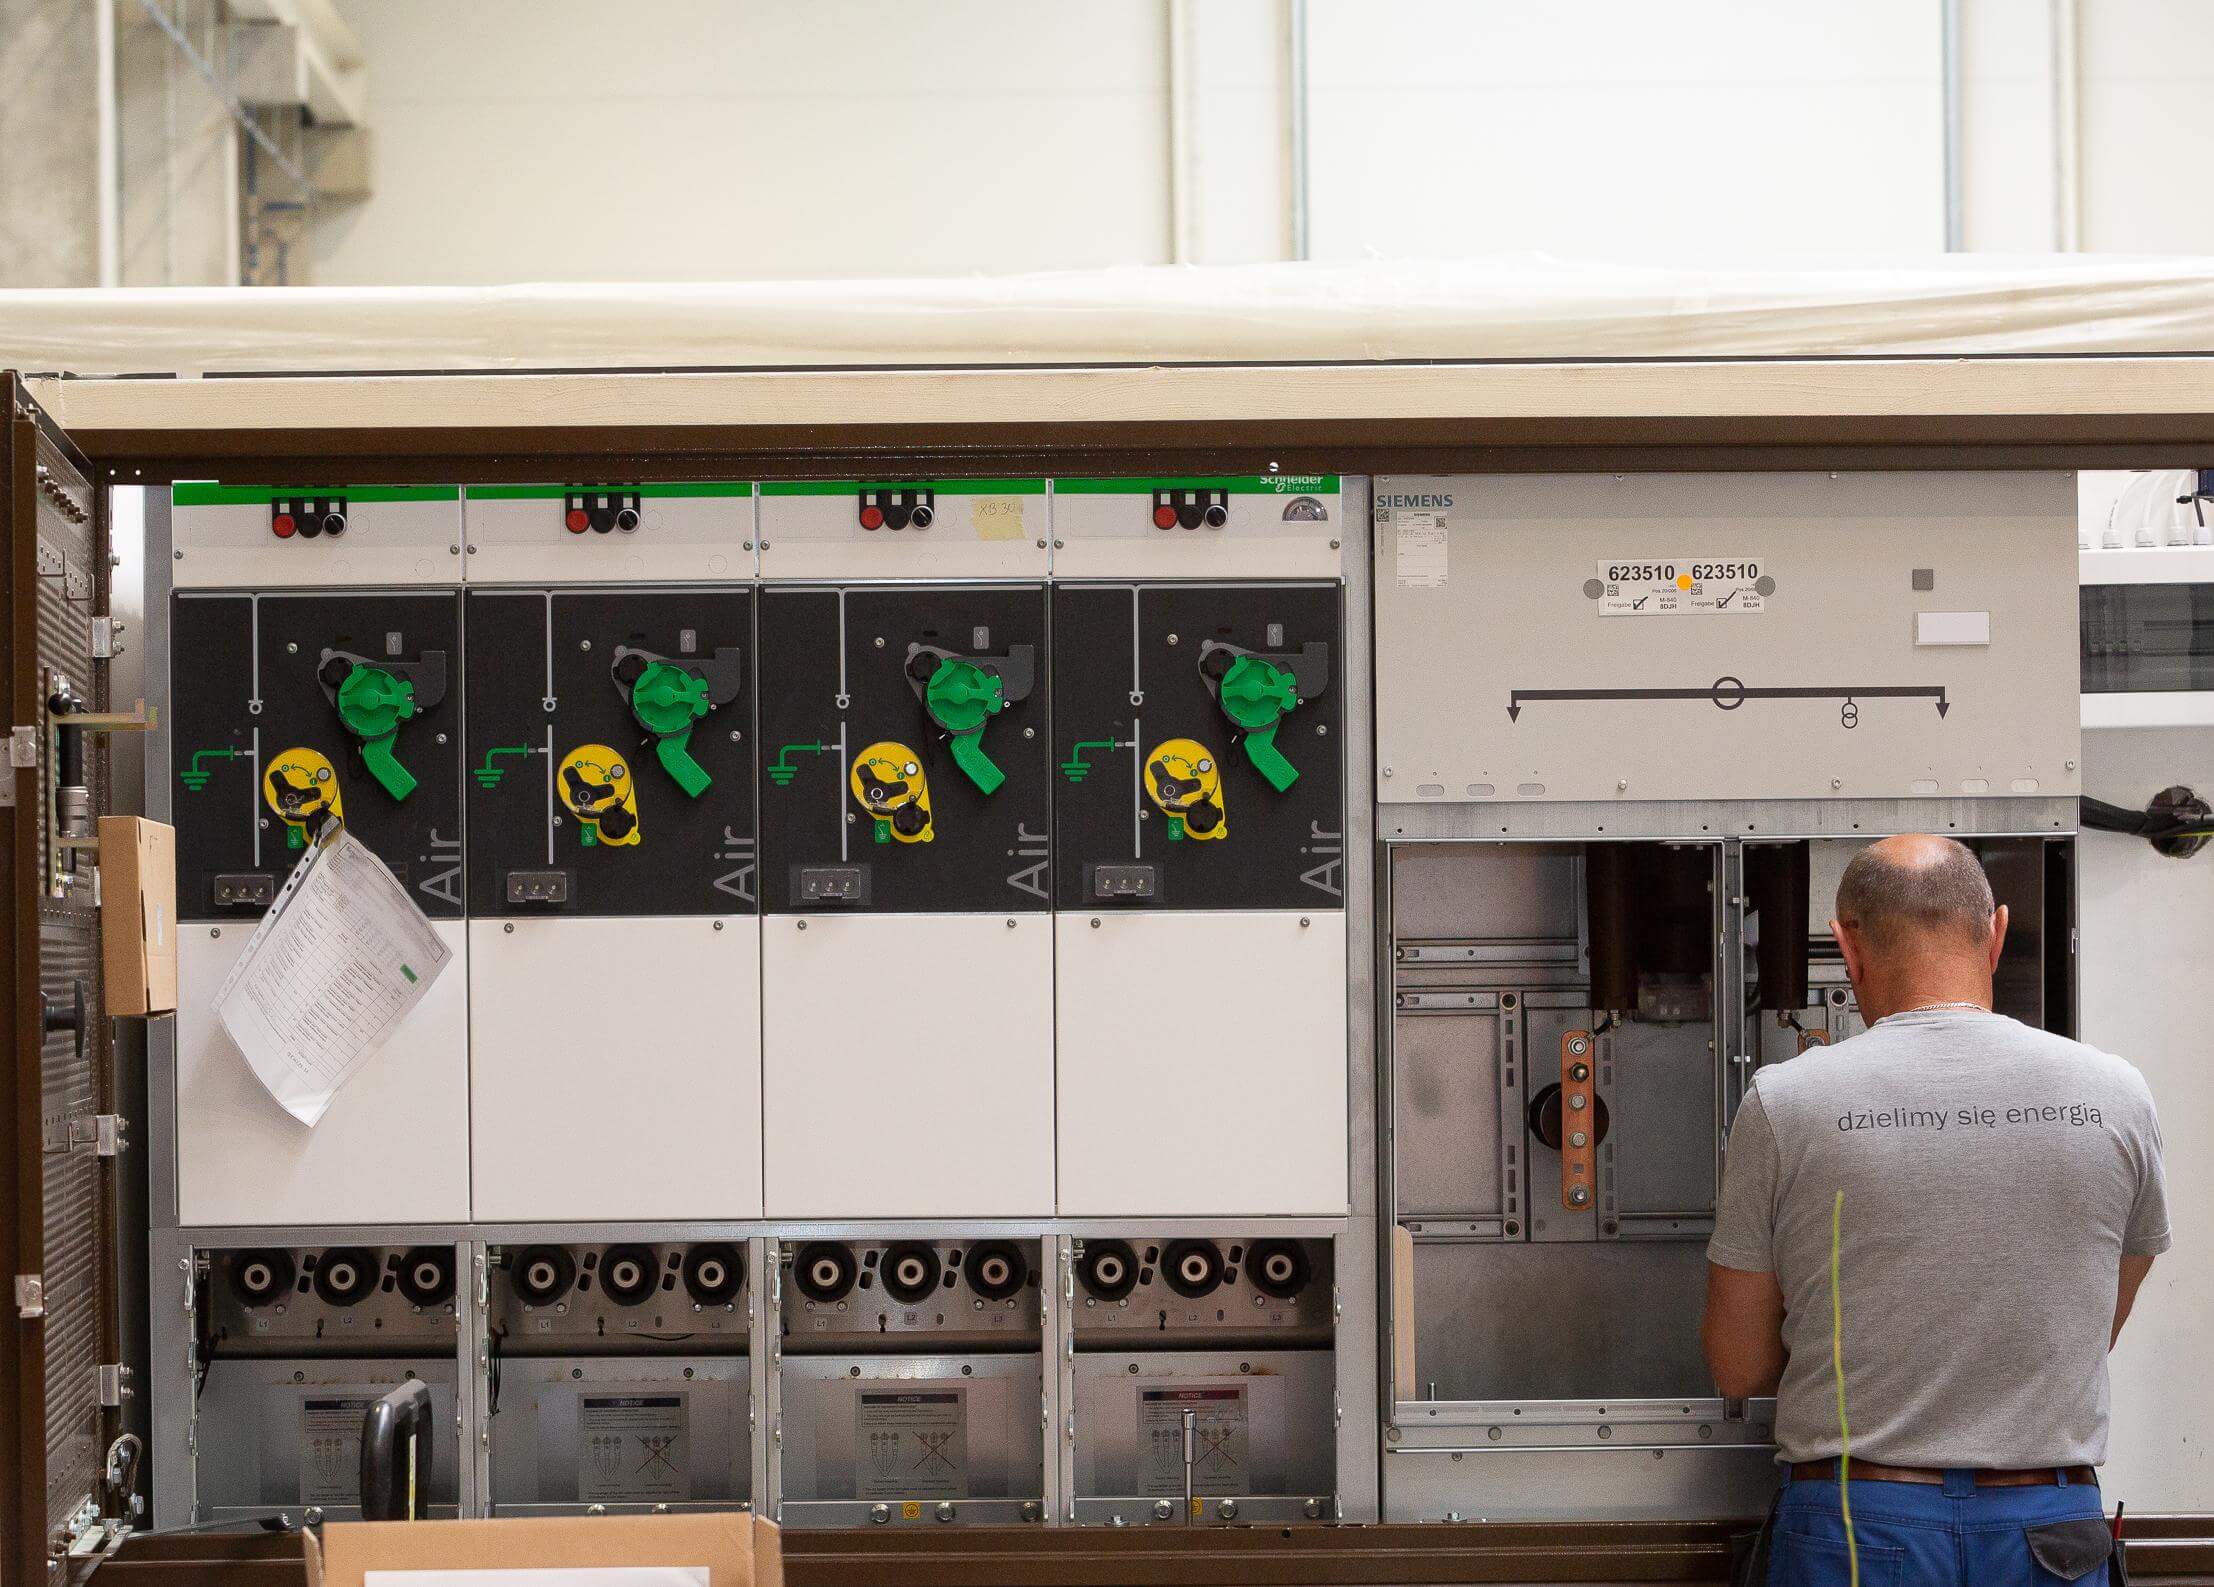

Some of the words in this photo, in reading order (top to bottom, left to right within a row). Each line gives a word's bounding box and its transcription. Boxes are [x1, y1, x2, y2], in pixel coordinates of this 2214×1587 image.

[1287, 484, 1322, 492] Electric
[1376, 494, 1454, 508] SIEMENS
[1608, 565, 1675, 581] 623510
[1692, 563, 1758, 580] 623510
[1607, 601, 1632, 609] Freigabe
[1691, 600, 1715, 608] Freigabe
[420, 828, 461, 904] Air
[713, 825, 755, 902] Air
[1007, 822, 1048, 899] Air
[1300, 820, 1341, 896] Air
[1838, 1107, 1949, 1131] dzielimy
[1957, 1105, 1997, 1128] się
[2006, 1102, 2104, 1128] energią
